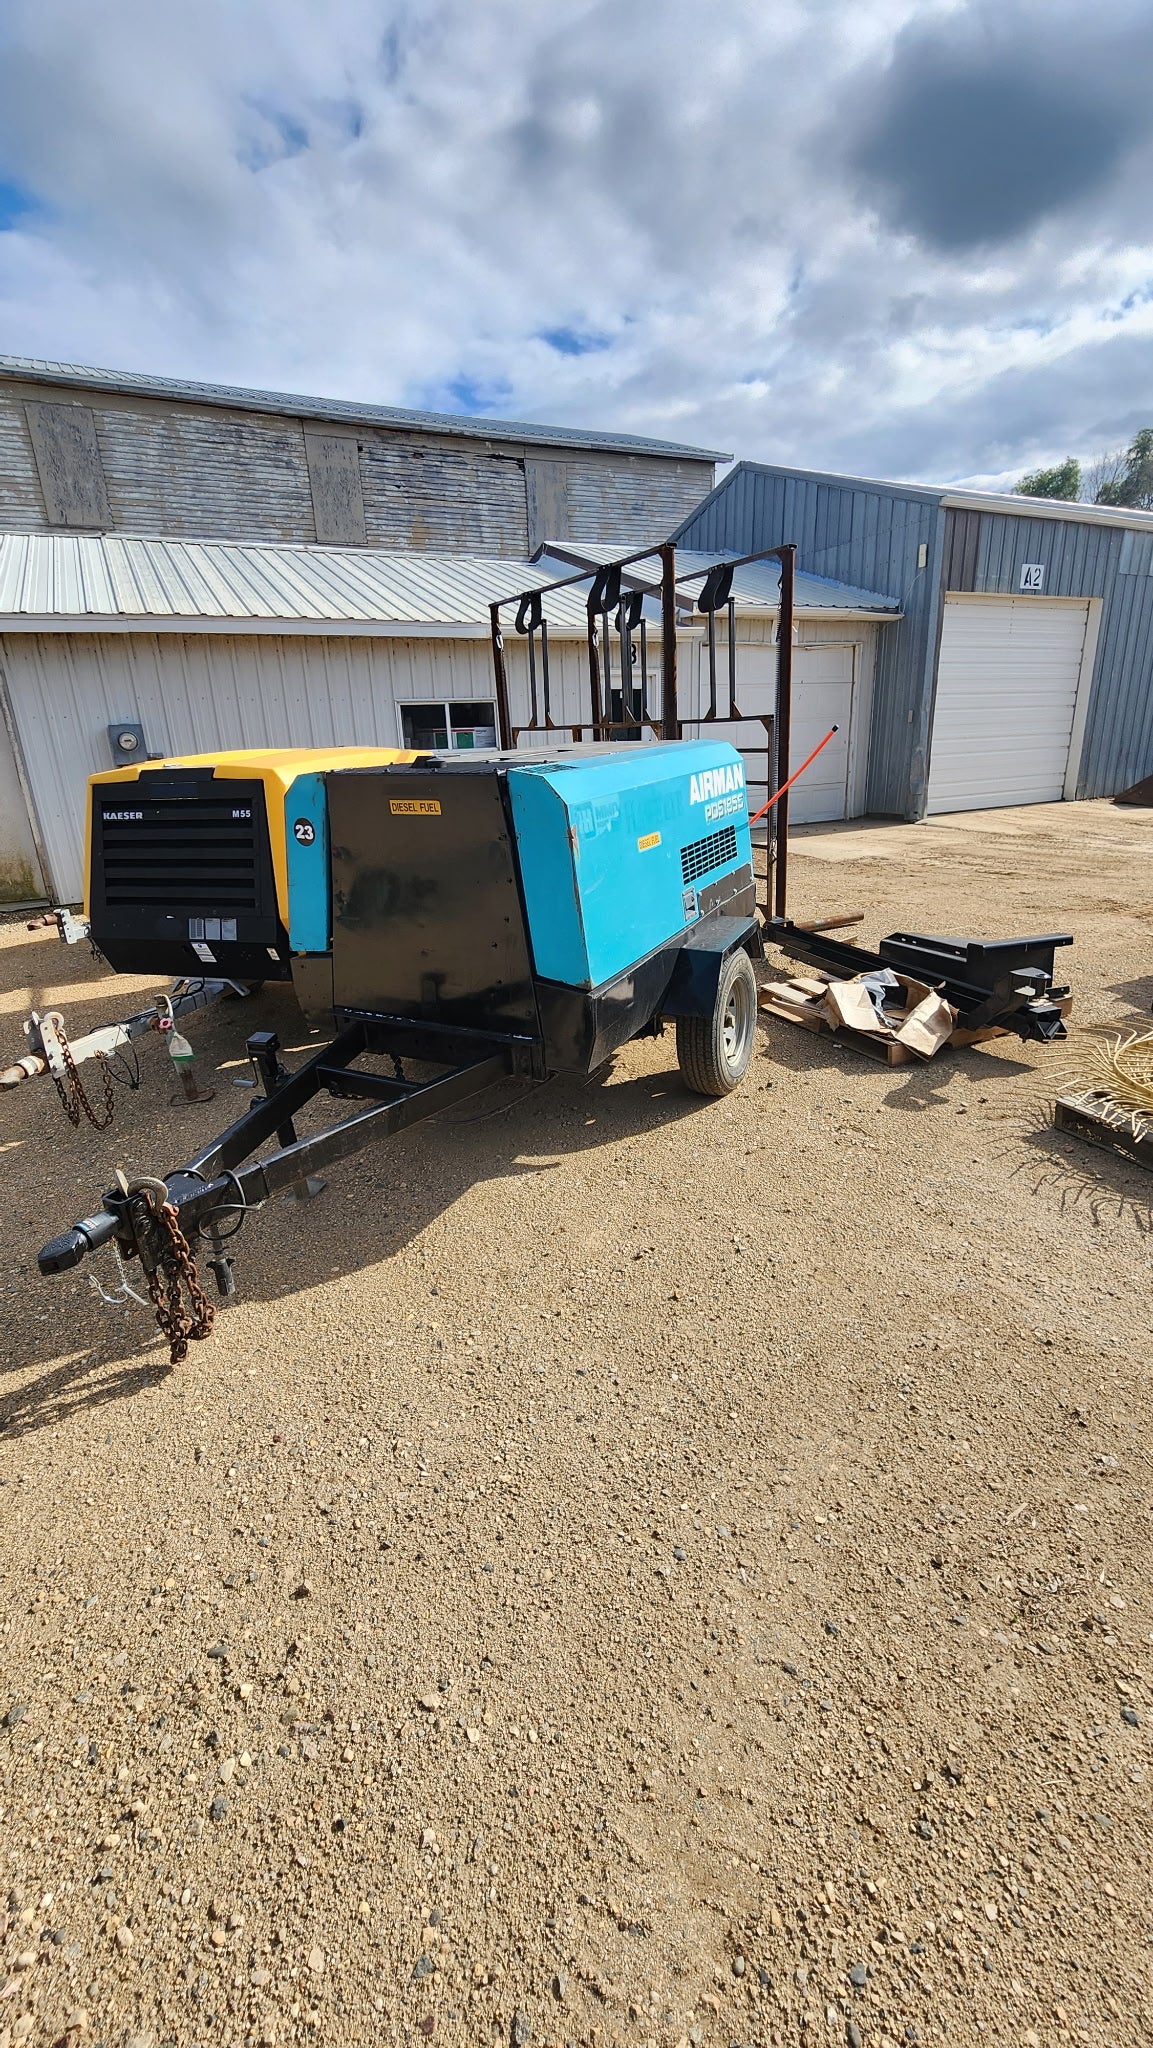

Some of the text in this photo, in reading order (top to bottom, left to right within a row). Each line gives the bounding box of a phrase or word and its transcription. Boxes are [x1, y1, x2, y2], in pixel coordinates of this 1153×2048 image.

[1024, 567, 1041, 587] A2
[690, 762, 744, 805] AIRMAN
[232, 809, 251, 818] M55
[391, 802, 439, 813] DIESEL FUEL
[103, 811, 143, 820] KAESER
[295, 825, 314, 840] 23
